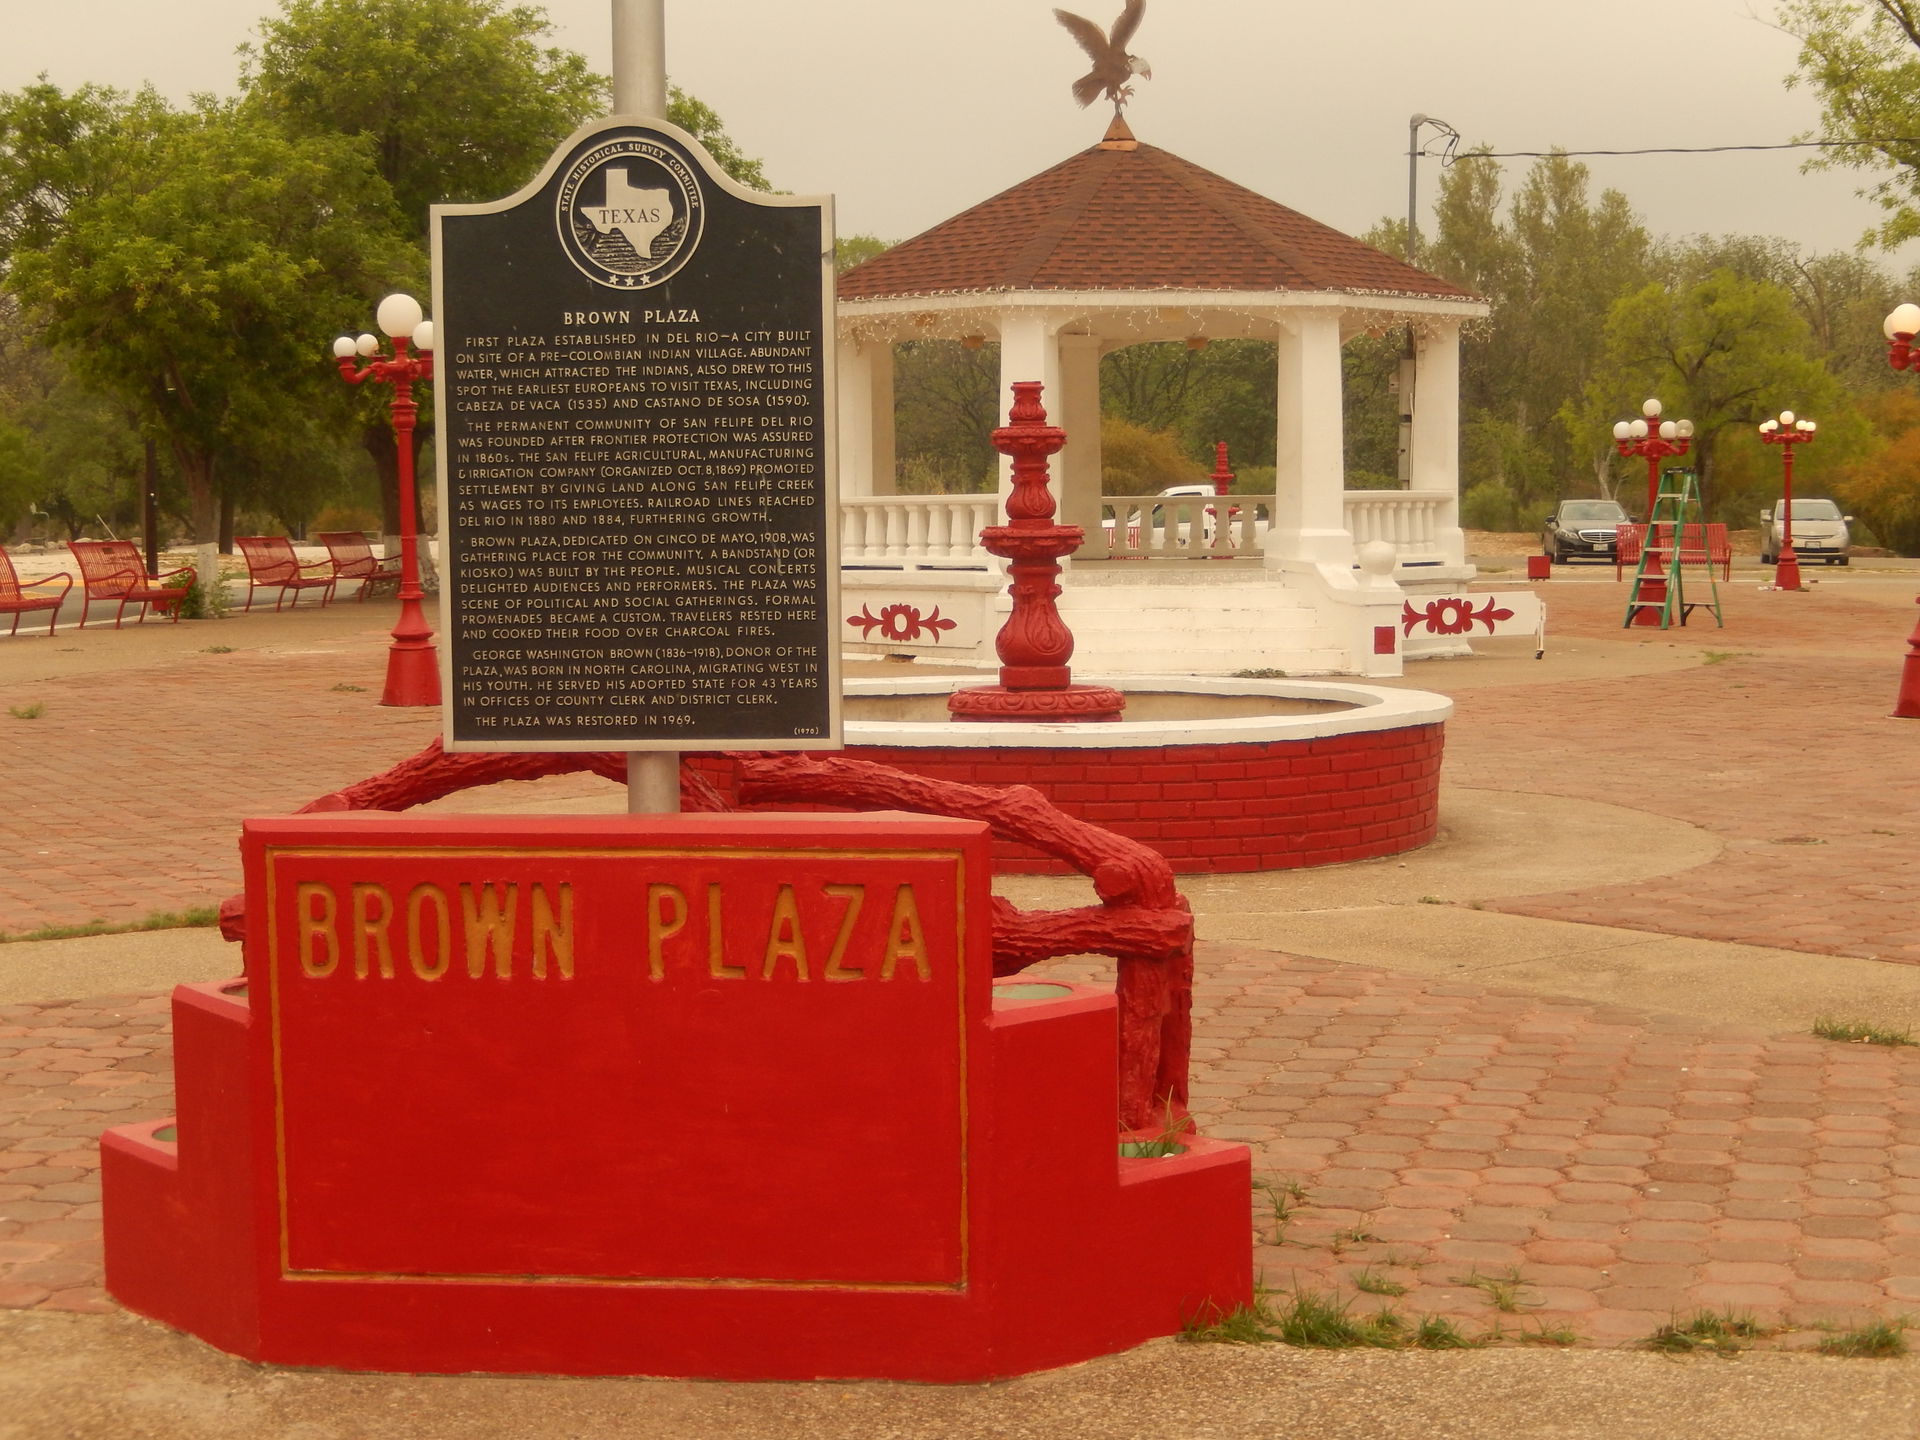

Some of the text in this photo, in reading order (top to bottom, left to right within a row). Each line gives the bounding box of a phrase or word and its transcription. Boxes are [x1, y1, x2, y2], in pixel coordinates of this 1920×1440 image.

[561, 143, 700, 212] STATE HISTORICAL SURVEY COMMITTEE
[599, 208, 660, 224] TEXAS
[564, 310, 700, 325] BROWN PLAZA
[466, 330, 810, 347] FIRST PLAZA ESTABLISHED DEL CITY BUILT
[478, 346, 811, 363] SITE INDIAN VILLAGE. ABUNDANT
[456, 362, 812, 381] WATER, WHICH ATTRACTED INDIANS, ALSO DREW THIS
[457, 378, 812, 396] SPOT EARLIEST EUROPEANS VISIT TEXAS, INCLUDING
[457, 393, 809, 411] CABEZA VACA (1535) AND CASTANO SOSA (1590).
[496, 415, 813, 431] PERMANENT COMMUNITY SAN FELIPE DEL RIO
[458, 430, 813, 447] WAS FOUNDED AFTER FRONTIER PROTECTION WAS ASSURED
[545, 447, 813, 462] SAN FELIPE AGRICULTURAL, MANUFACTURING
[469, 463, 814, 478] IRRIGATION COMPANY PROMOTED
[459, 479, 813, 495] SETTLEMENT GIVING LAND ALONG SAN FELIPE CREEK
[480, 494, 814, 510] WAGES EMPLOYEES. RAILROAD LINES REACHED
[459, 511, 772, 526] DEL RIO 1880 AND 1884, FURTHERING GROWTH.
[471, 532, 814, 547] BROWN PLAZA, DEDICATED CINCO MAYO, 1908, WAS
[460, 548, 790, 562] GATHERING PLACE FOR COMMUNITY. BANDSTAND
[518, 563, 815, 577] WAS BUILT PEOPLE. MUSICAL CONCERTS
[461, 578, 816, 593] DELIGHTED AUDIENCES AND PERFORMERS. PLAZA WAS
[461, 594, 815, 609] SCENE POLITICAL AND SOCIAL GATHERINGS. FORMAL
[462, 609, 816, 624] PROMENADES BECAME CUSTOM. TRAVELERS RESTED HERE
[462, 625, 774, 639] AND COOKED THEIR FOOD OVER CHARCOAL FIRES.
[472, 646, 770, 660] GEORGE WASHINGTON BROWN DONOR
[463, 662, 799, 677] PLAZA, WAS BORN NORTH CAROLINA, MIGRATING WEST
[463, 678, 817, 691] HIS YOUTH. SERVED HIS ADOPTED STATE FOR YEARS
[480, 694, 777, 706] OFFICES COUNTY CLERK AND DISTRICT CLERK.
[503, 714, 695, 726] PLAZA WAS RESTORED 1969.
[297, 881, 932, 983] BROWN PLAZA
